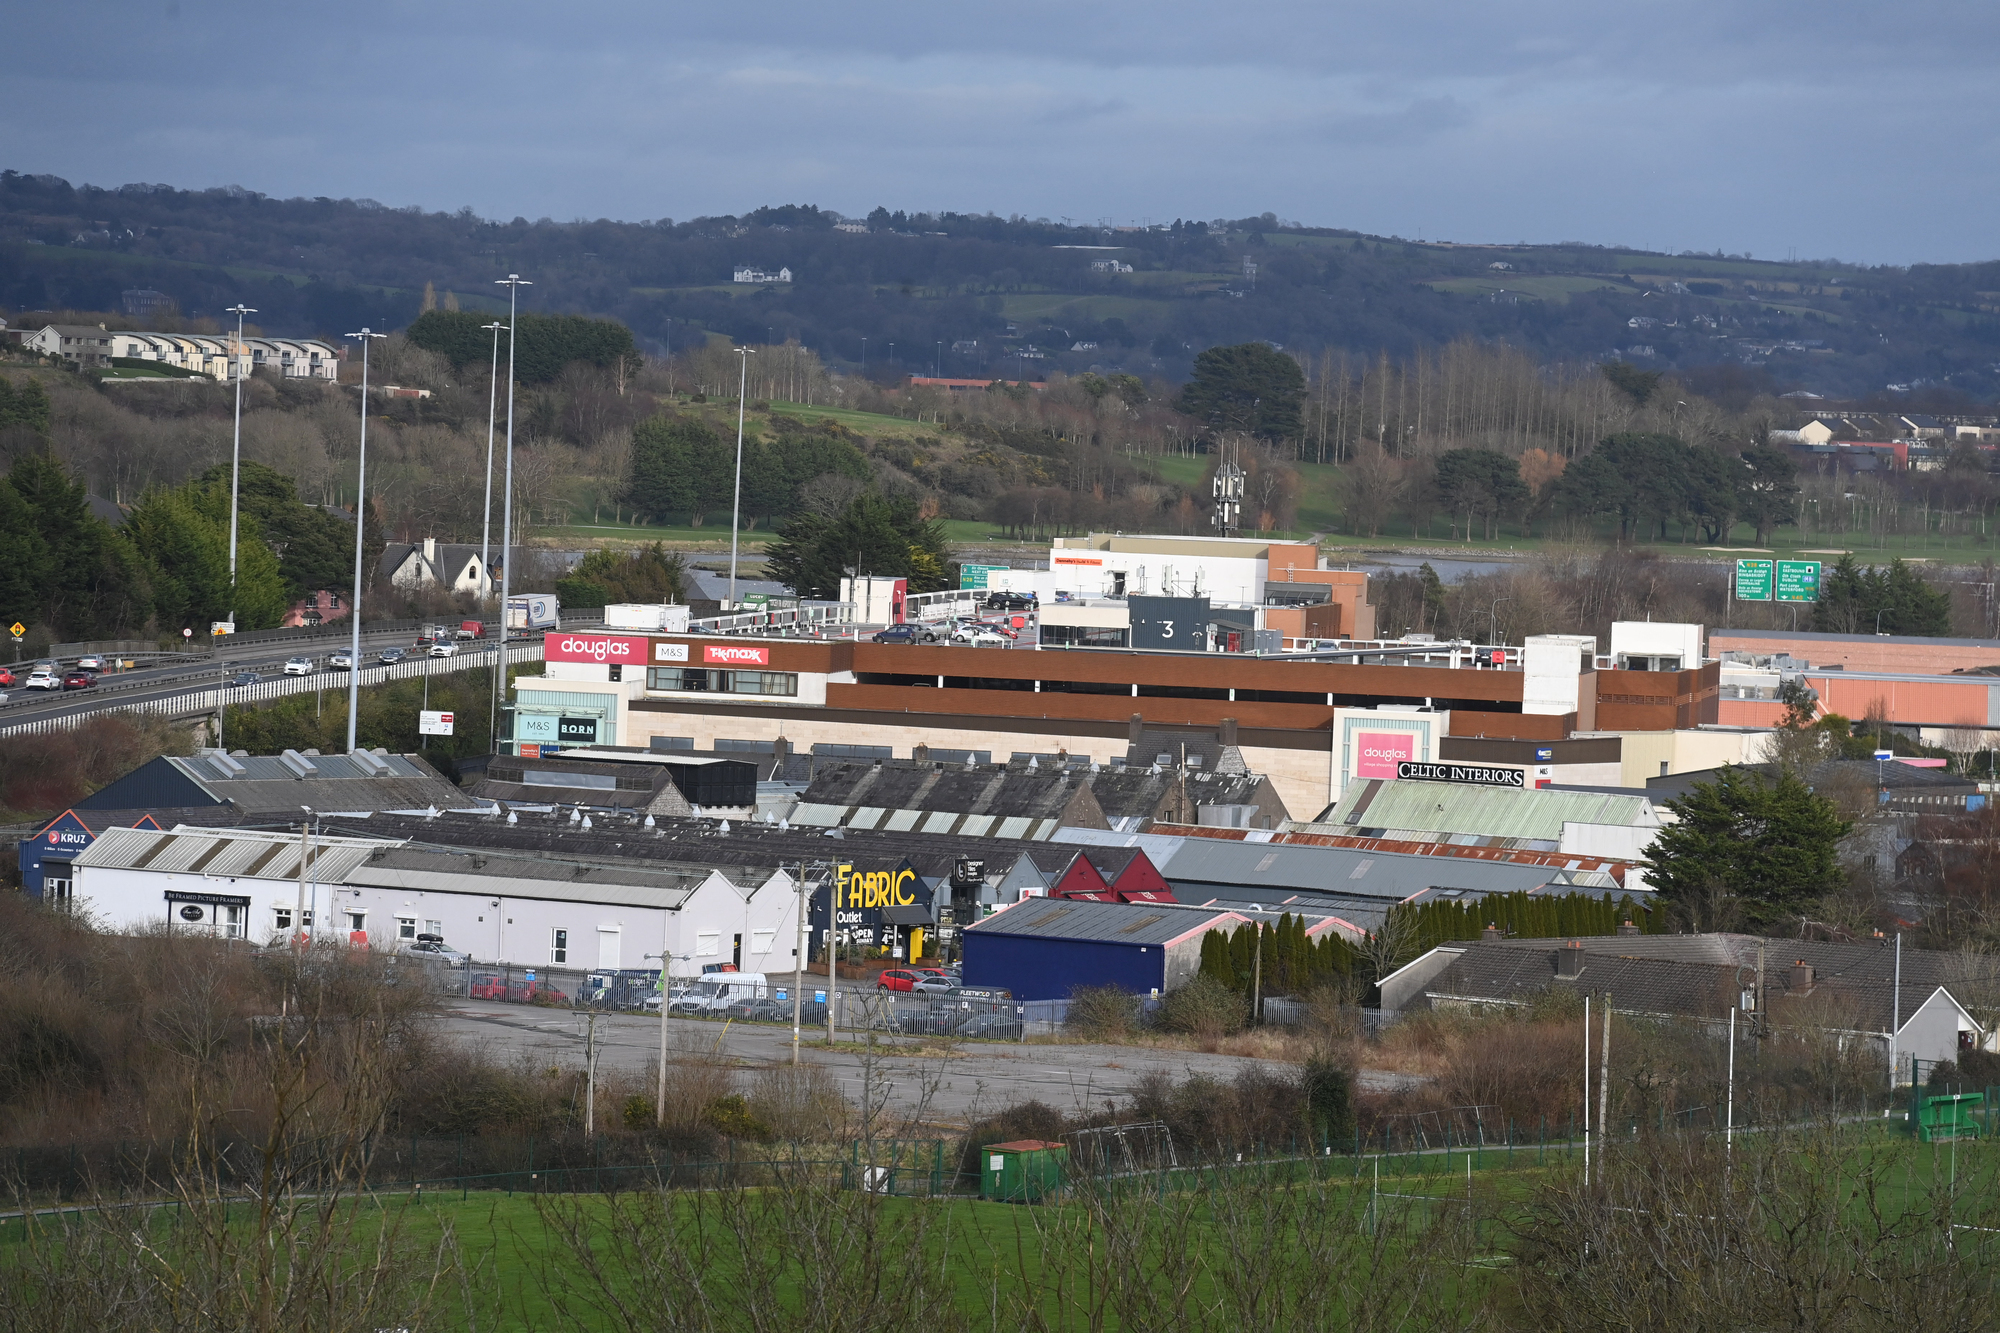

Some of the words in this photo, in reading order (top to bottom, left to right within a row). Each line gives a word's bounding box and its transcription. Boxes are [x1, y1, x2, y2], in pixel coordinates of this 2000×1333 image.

[1162, 620, 1174, 638] 3
[561, 637, 630, 660] douglas
[661, 648, 682, 657] M&S
[527, 721, 549, 731] M&S
[561, 724, 594, 734] BORN
[1364, 748, 1406, 762] douglas
[1399, 763, 1446, 778] CELTIC
[1450, 767, 1523, 786] INTERIORS
[61, 833, 86, 844] KRUZ
[836, 865, 916, 908] FABRIC
[836, 911, 862, 923] Outlet
[851, 929, 873, 939] OPEN
